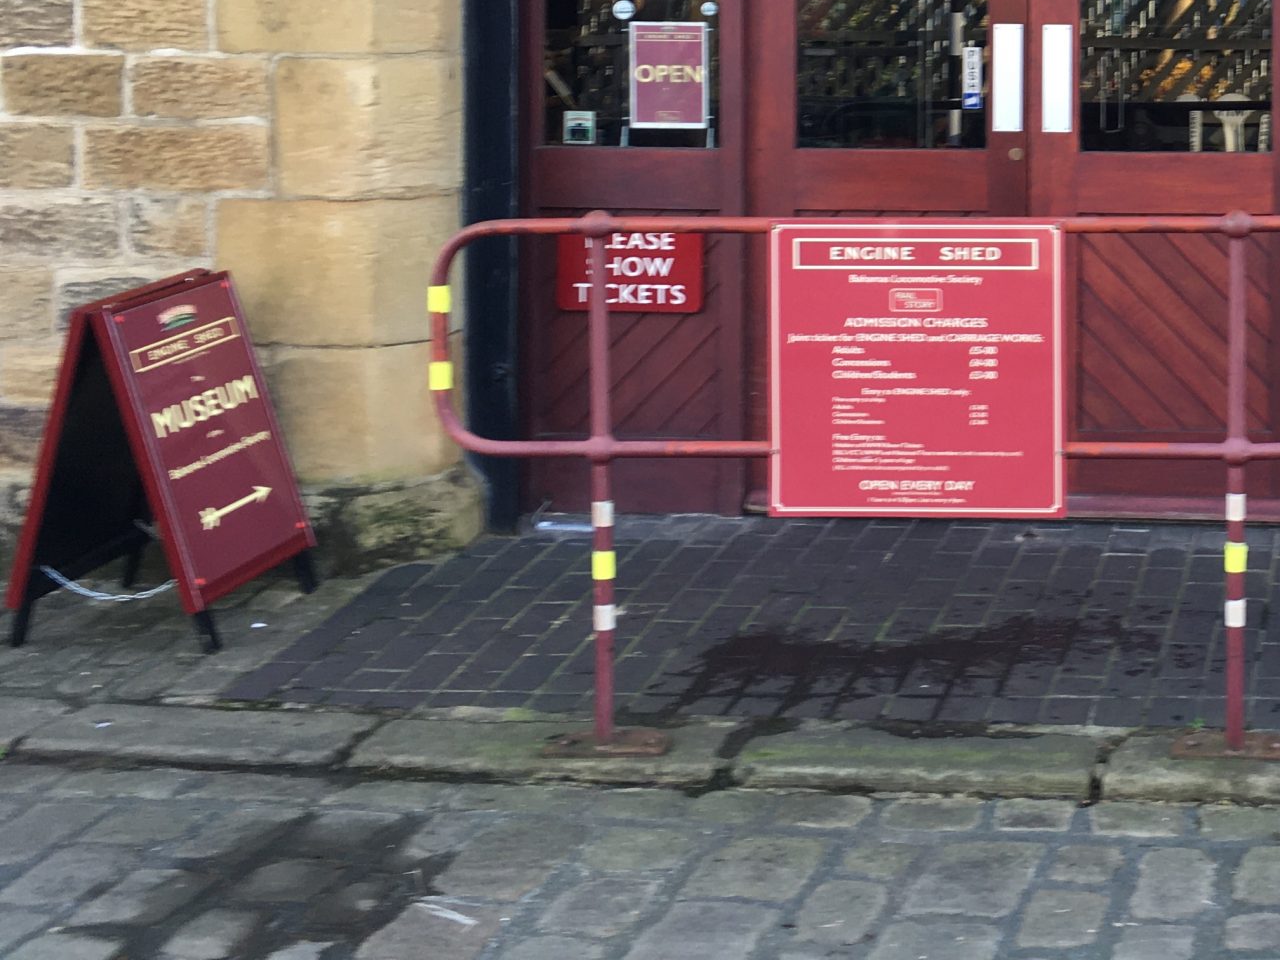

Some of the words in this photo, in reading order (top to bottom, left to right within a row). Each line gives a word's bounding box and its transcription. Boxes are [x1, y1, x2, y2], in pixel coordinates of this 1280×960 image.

[633, 64, 705, 83] OPEN
[829, 246, 916, 261] ENGINE
[938, 246, 1002, 261] SHED
[585, 256, 675, 277] HOW
[572, 282, 687, 305] TCKETS
[843, 317, 922, 328] ADMISSION
[922, 317, 989, 328] CHARGES
[150, 374, 260, 439] MUSEUM
[859, 480, 899, 491] OPEN
[900, 480, 943, 491] EVERY
[944, 480, 976, 491] DAY
